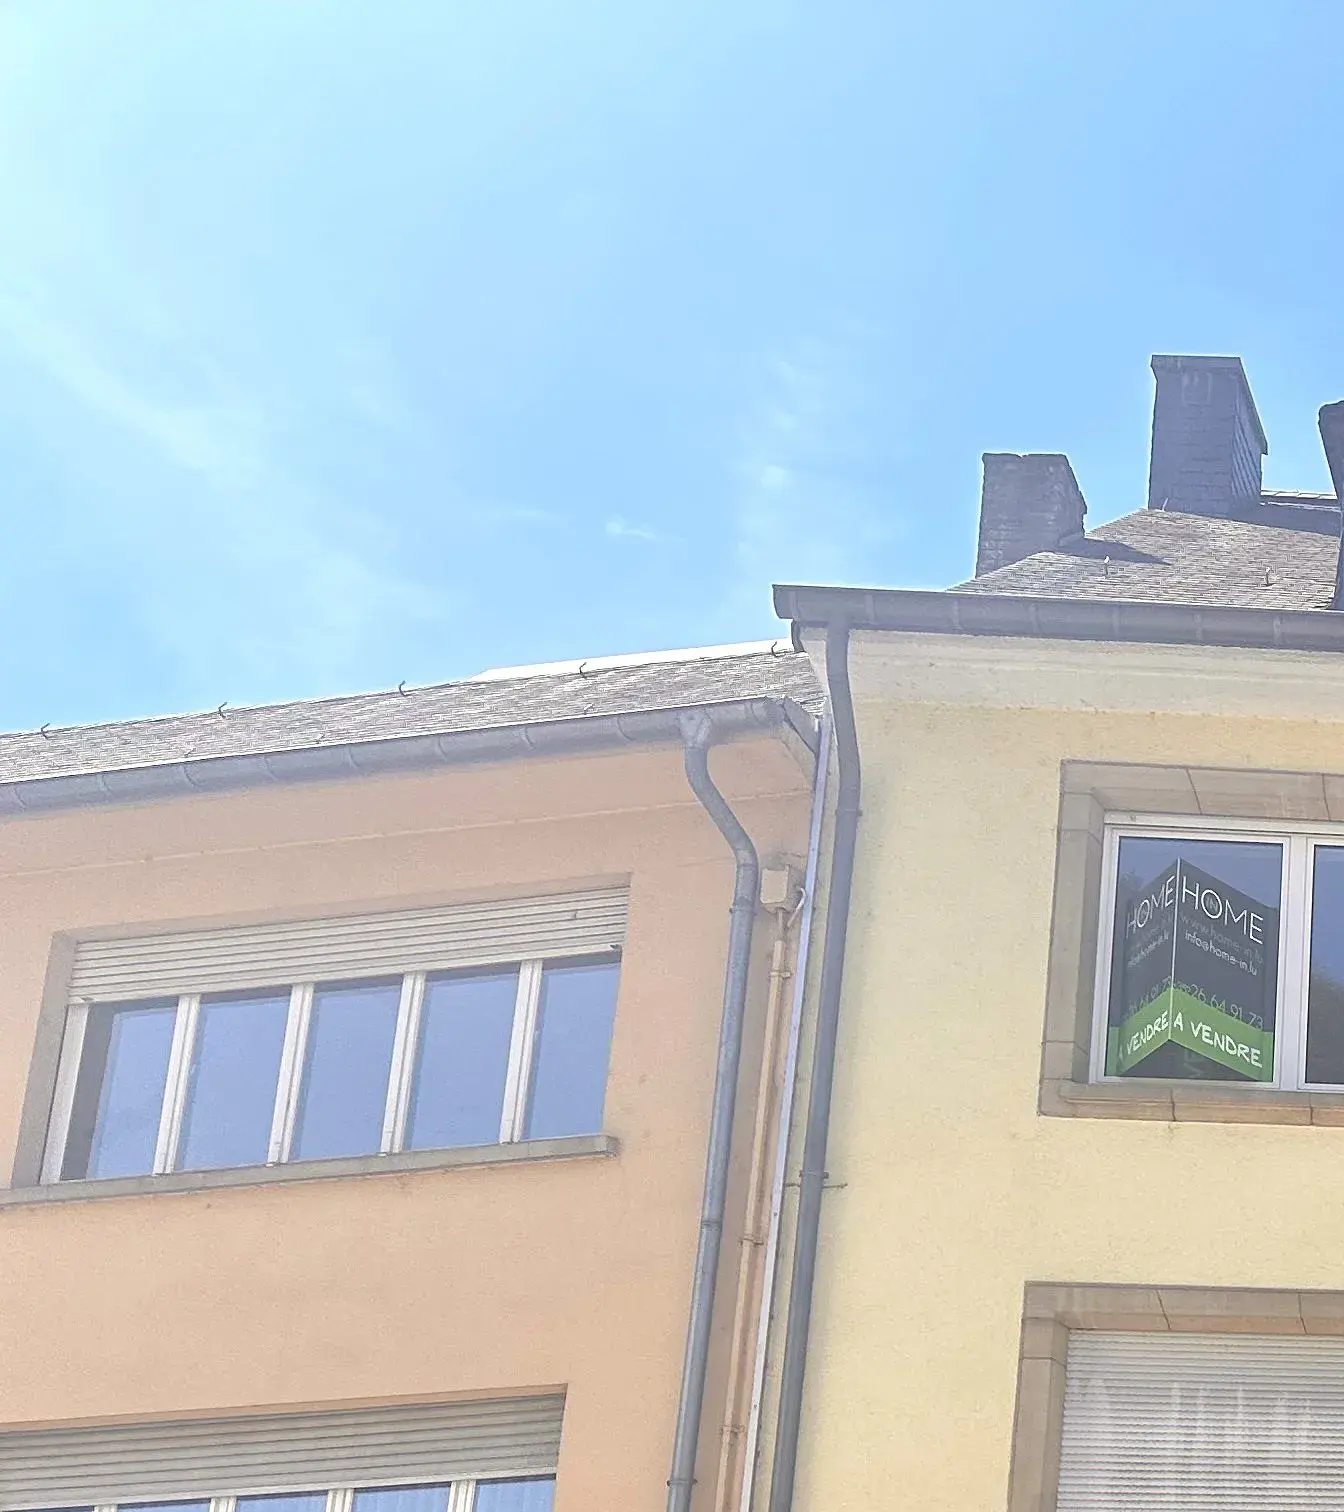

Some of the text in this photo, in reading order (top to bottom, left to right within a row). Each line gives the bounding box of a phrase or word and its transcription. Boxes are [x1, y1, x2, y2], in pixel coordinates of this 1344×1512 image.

[1126, 875, 1175, 939] HOME
[1181, 875, 1264, 945] HOME
[1126, 1010, 1170, 1056] VENDRE
[1173, 1011, 1263, 1068] A VENDRE
